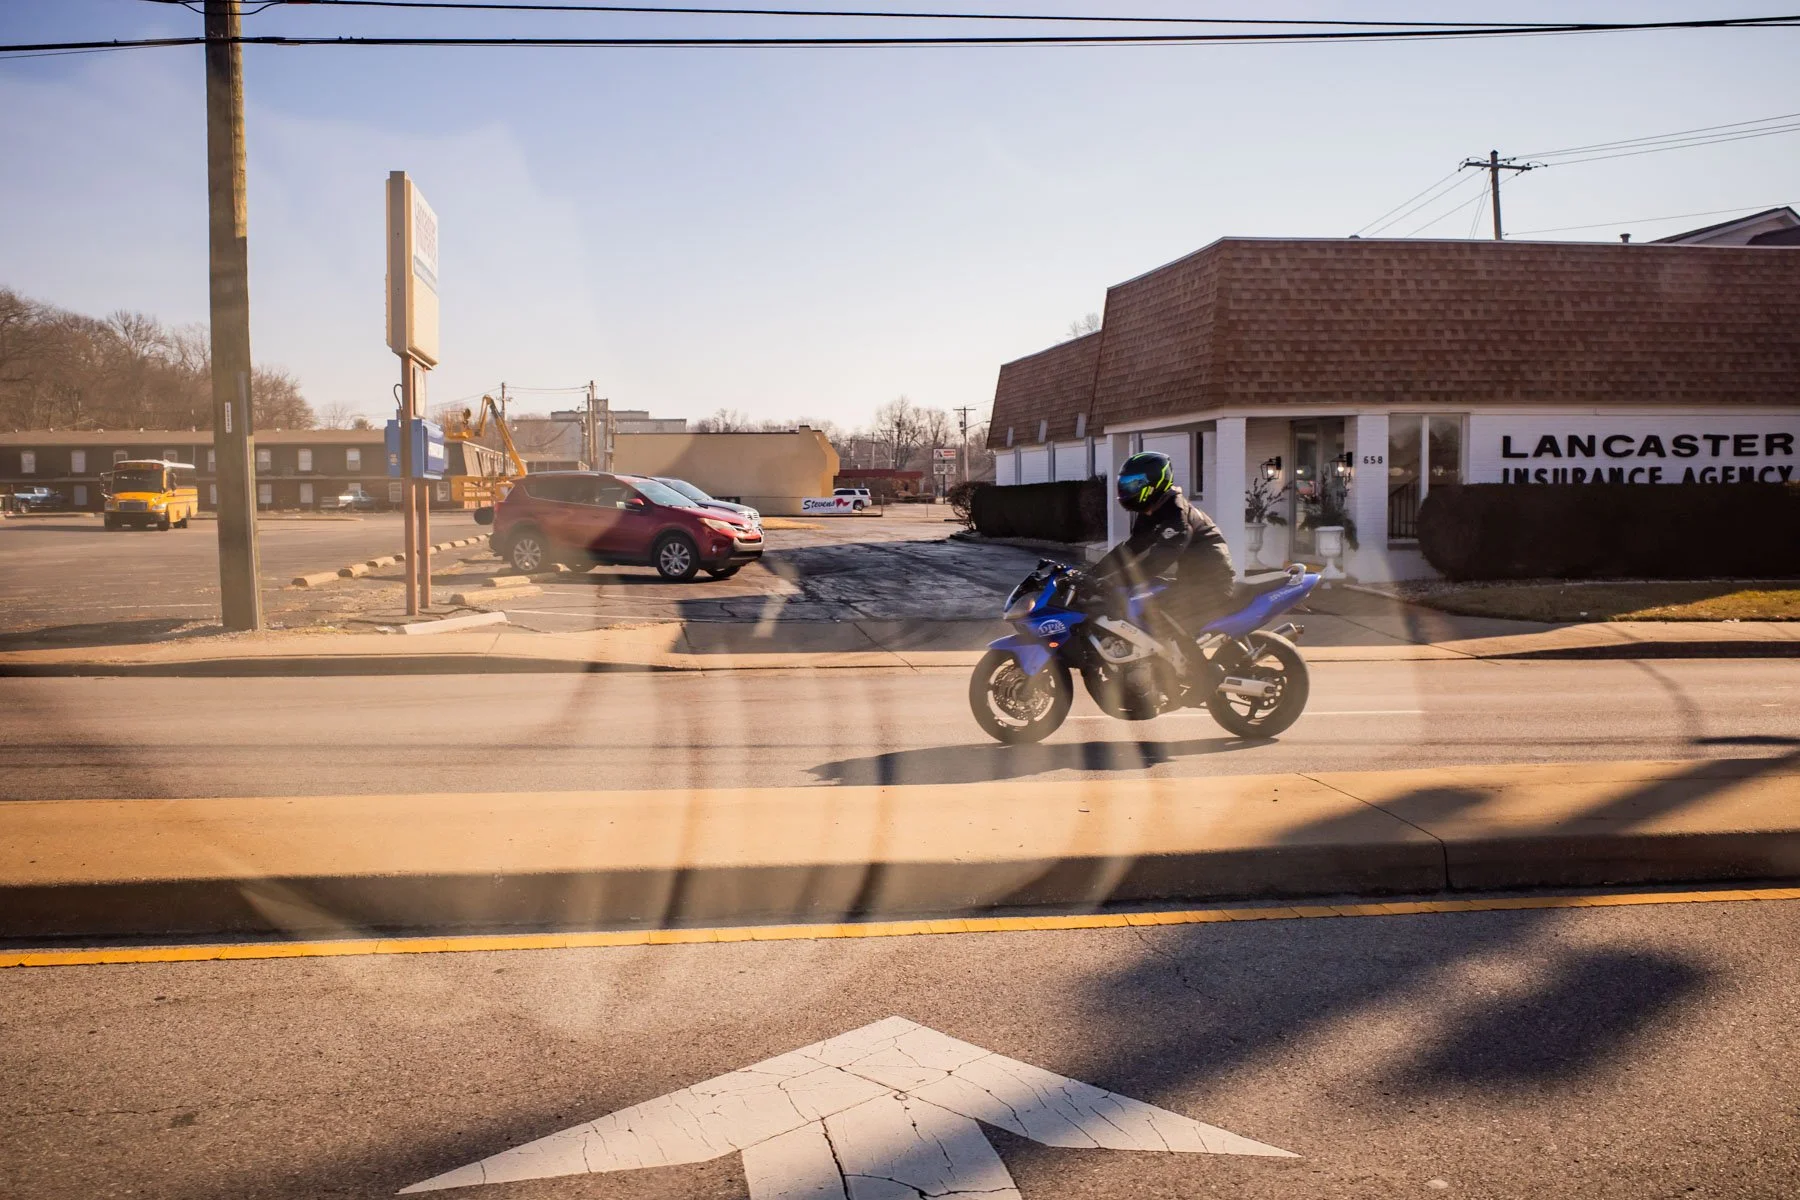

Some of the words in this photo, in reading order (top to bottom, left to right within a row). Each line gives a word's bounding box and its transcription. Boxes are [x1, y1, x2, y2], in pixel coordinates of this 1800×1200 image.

[1502, 433, 1794, 458] LANCASTER
[1363, 455, 1383, 464] 658
[1503, 467, 1662, 484] INSURANCE
[1681, 465, 1794, 484] AGENCY
[803, 499, 836, 510] Stevens
